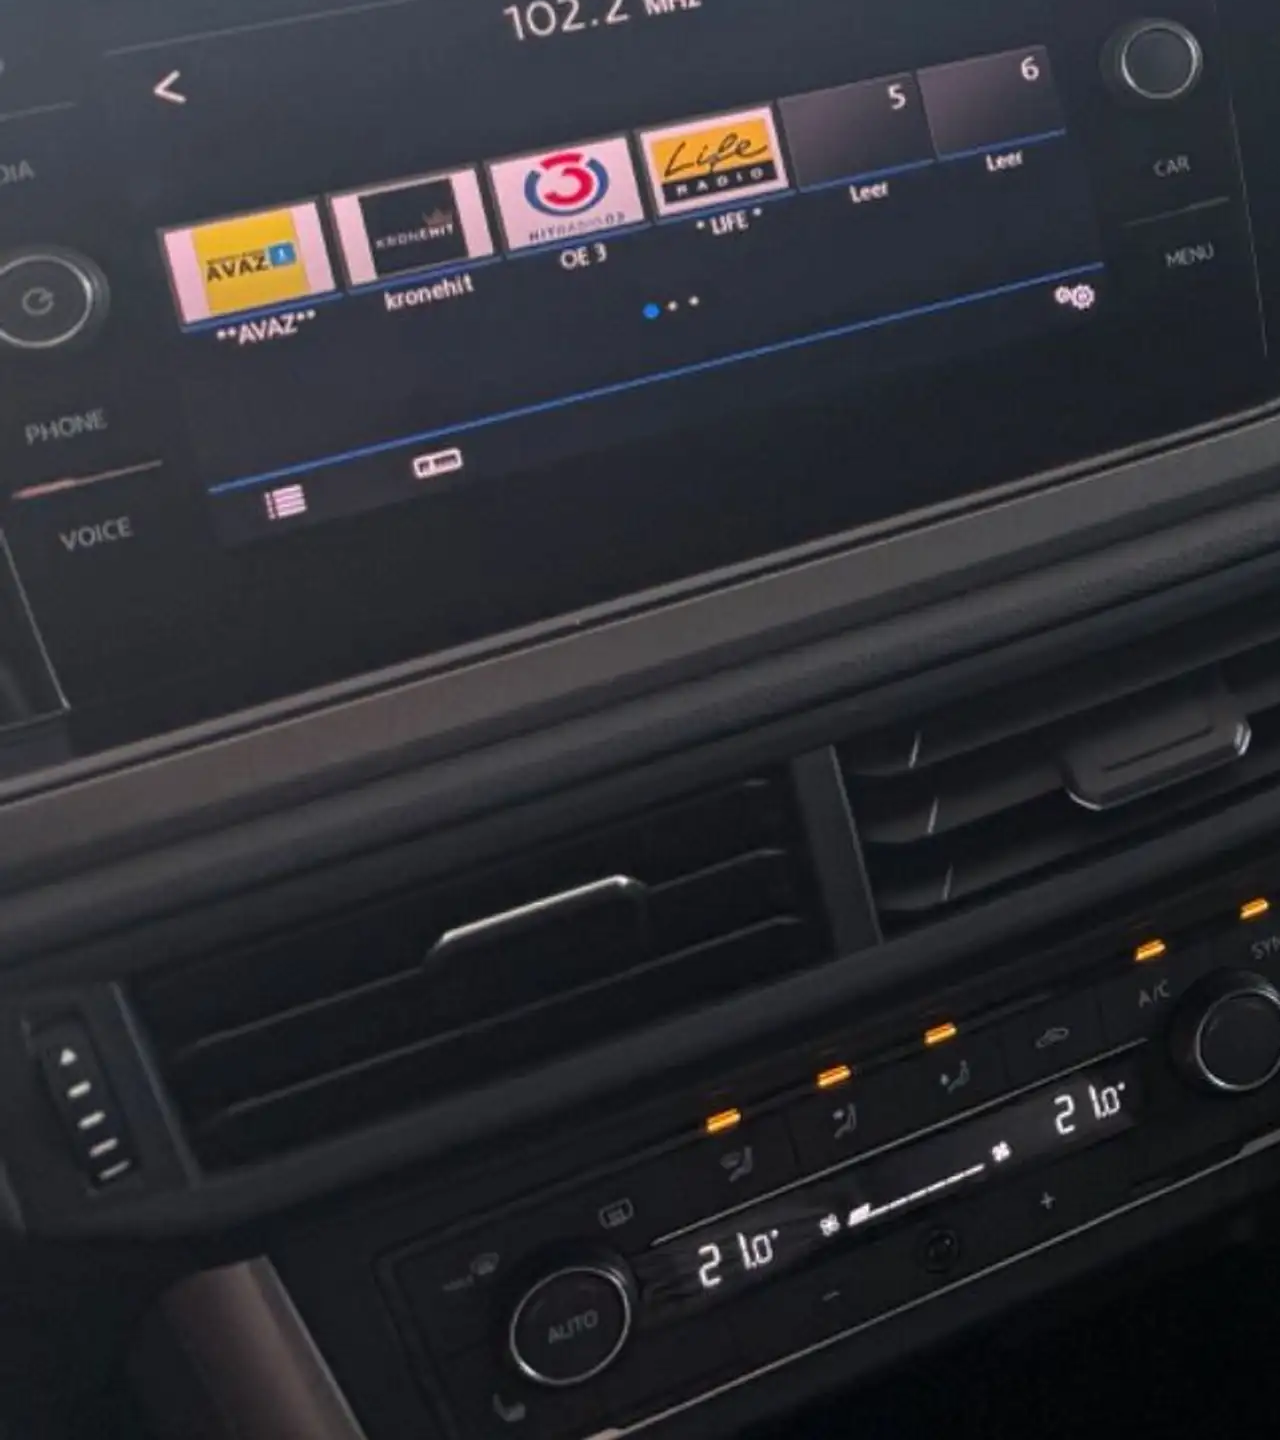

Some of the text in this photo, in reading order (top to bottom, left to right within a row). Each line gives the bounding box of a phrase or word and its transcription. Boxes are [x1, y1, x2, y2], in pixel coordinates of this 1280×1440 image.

[1020, 56, 1040, 81] 6
[888, 83, 907, 110] 5
[664, 131, 769, 177] Life
[985, 150, 1024, 172] Leer
[1153, 154, 1191, 178] CAR
[675, 167, 764, 197] RADIO
[849, 181, 889, 205] Leer
[375, 223, 454, 250] KRONEHIT
[559, 242, 608, 271] OE 3
[1164, 240, 1215, 267] MENU
[206, 255, 270, 283] AVAZ
[383, 273, 474, 312] kronehit
[25, 408, 108, 446] PHONE
[58, 516, 133, 552] VOICE
[1138, 978, 1170, 1009] A/C
[548, 1308, 600, 1345] AUTO
